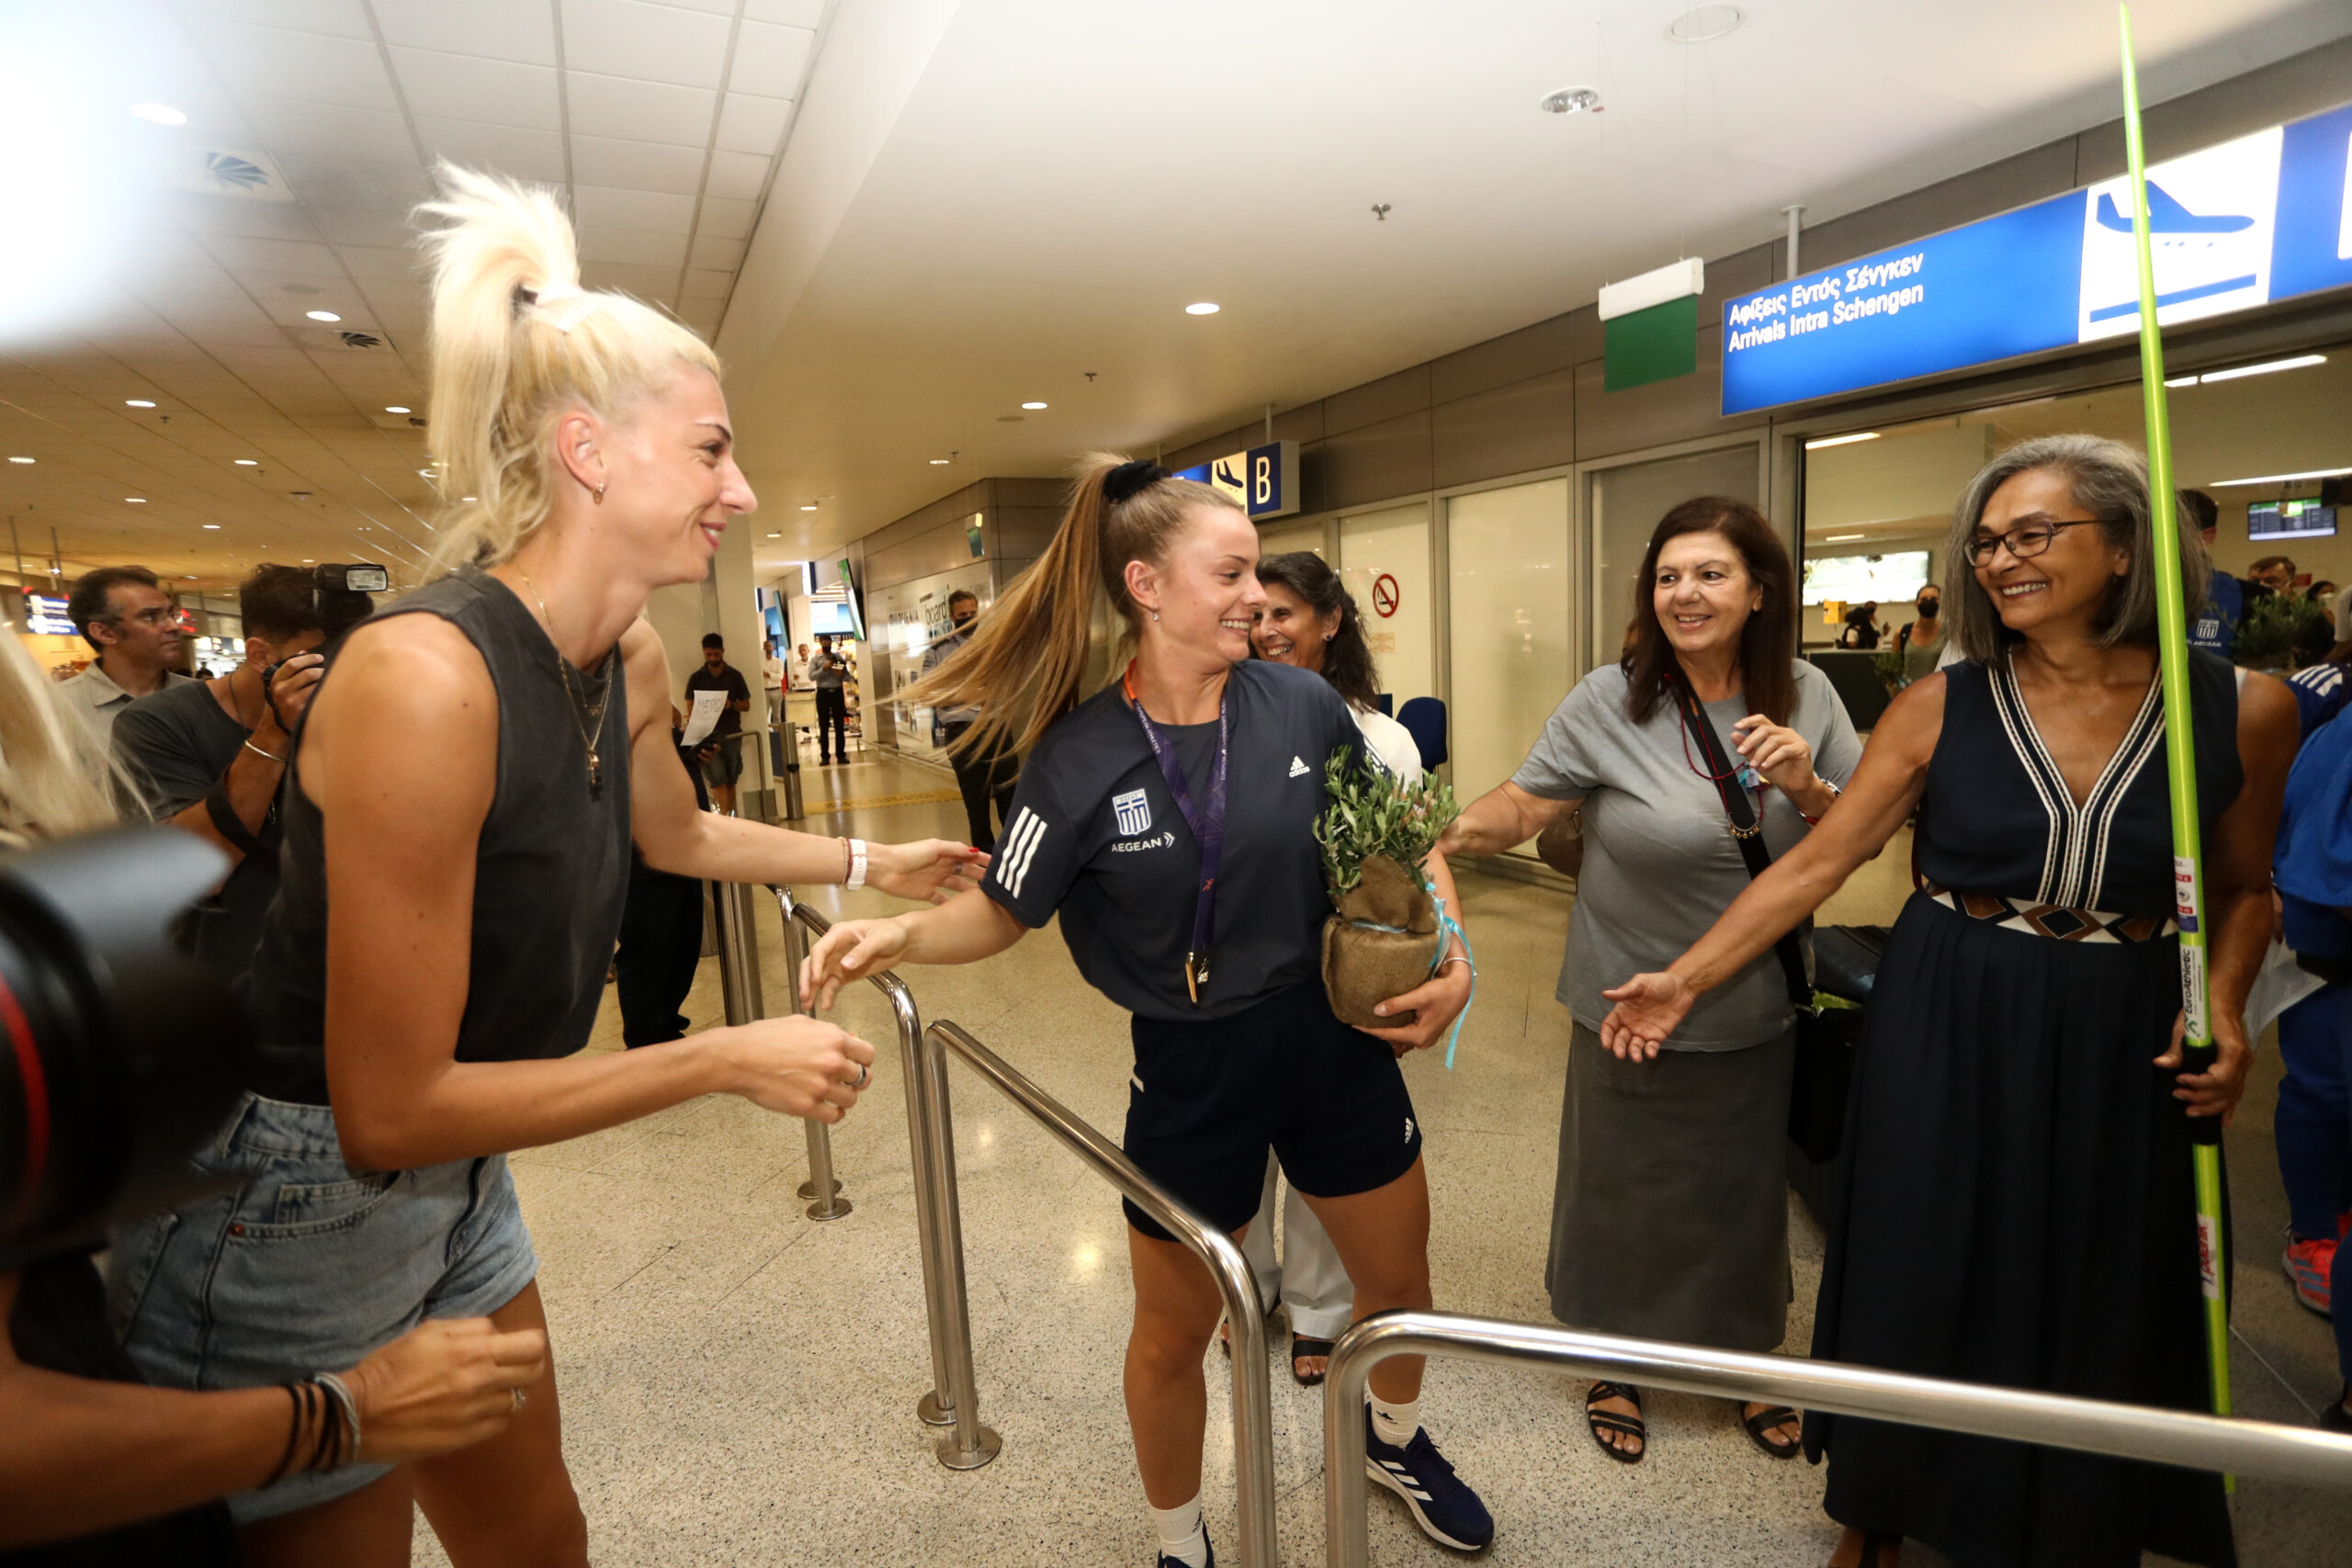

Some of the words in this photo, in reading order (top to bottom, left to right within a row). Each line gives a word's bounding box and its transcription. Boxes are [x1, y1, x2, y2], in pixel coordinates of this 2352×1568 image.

[1791, 276, 1841, 308] Εντός
[1845, 253, 1924, 293] Σένγκεν
[1728, 320, 1786, 353] Arrivals
[1790, 310, 1828, 336] Intra
[1833, 285, 1924, 324] Schengen
[1256, 456, 1272, 504] B
[1111, 837, 1162, 852] AEGEAN
